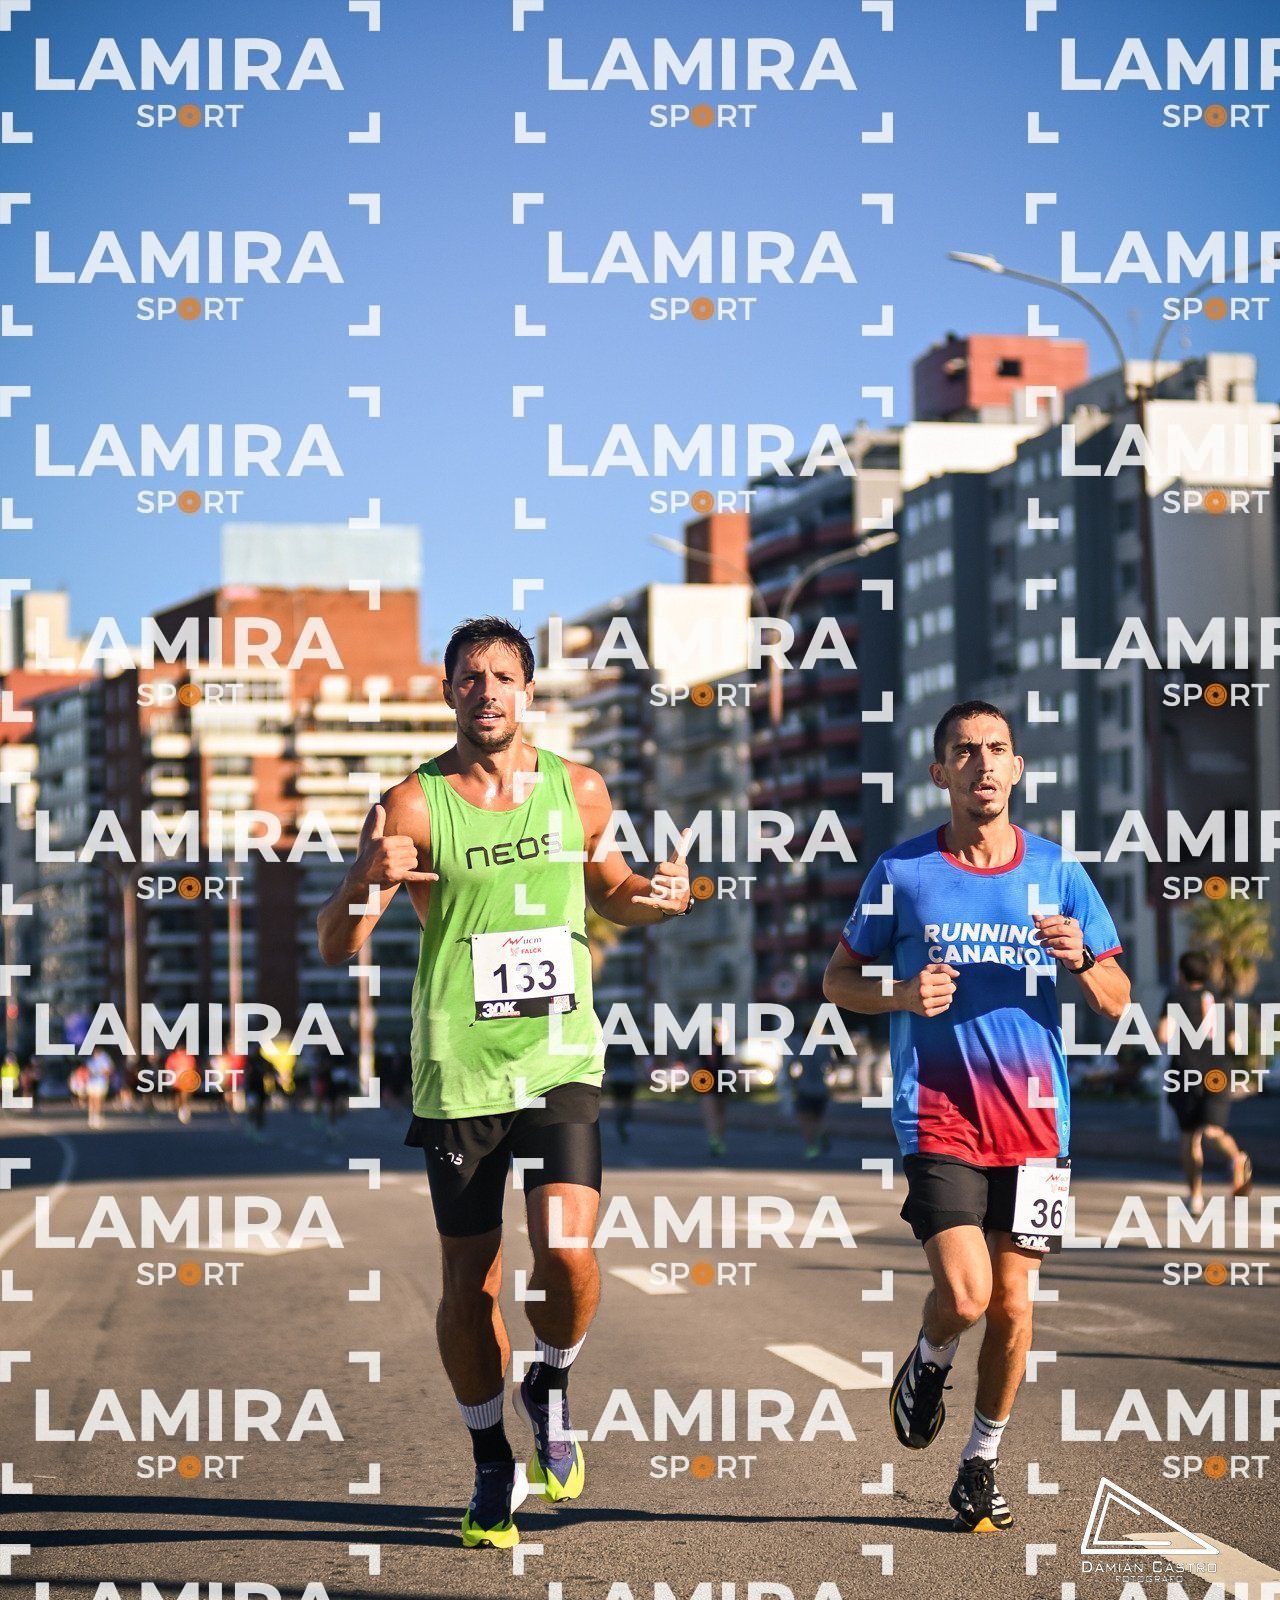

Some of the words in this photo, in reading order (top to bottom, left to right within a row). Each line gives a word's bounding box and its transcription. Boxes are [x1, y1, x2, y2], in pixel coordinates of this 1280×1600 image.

[465, 832, 563, 870] NEOS
[928, 944, 1041, 966] CANARIO
[493, 959, 557, 994] 133
[482, 1001, 517, 1018] 30K
[1031, 1198, 1062, 1229] 36
[1015, 1235, 1050, 1249] 30K
